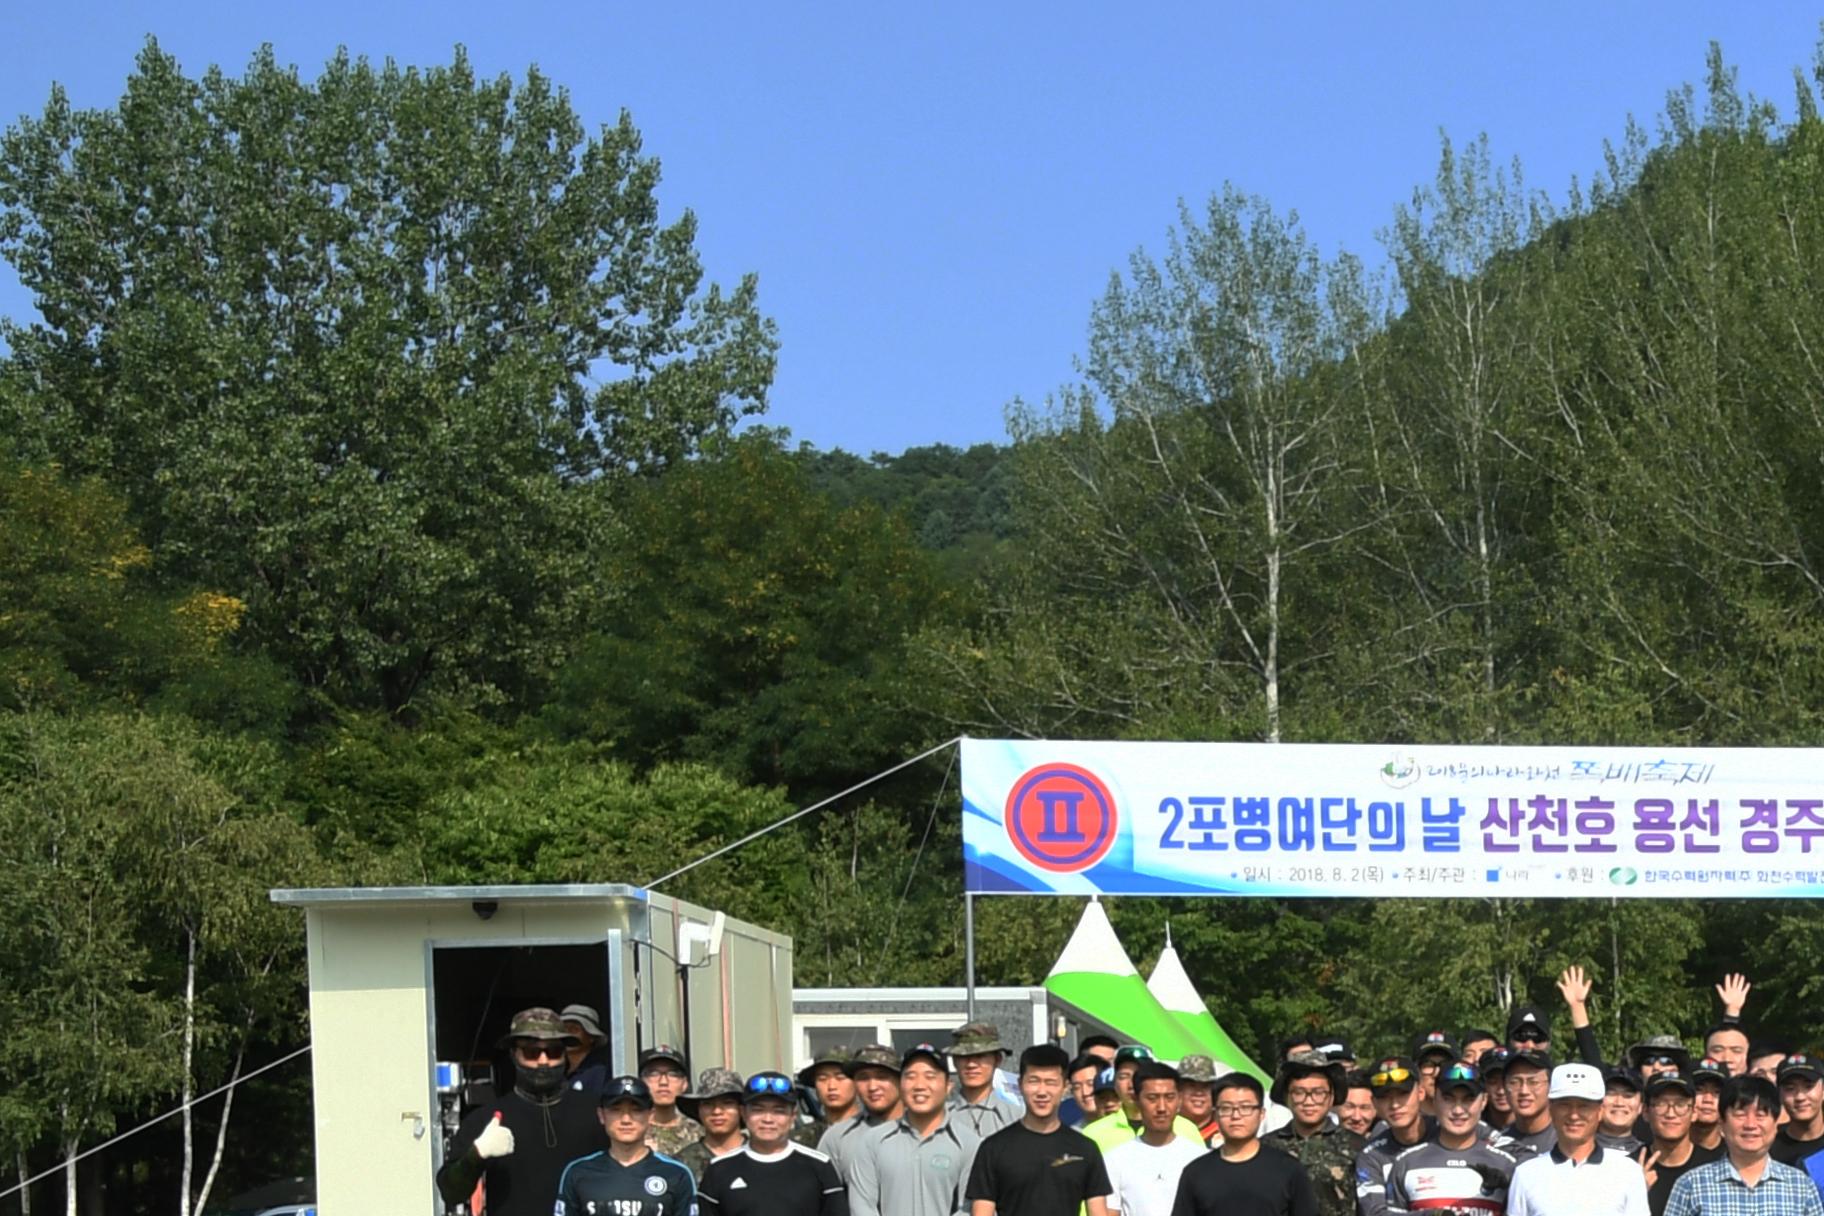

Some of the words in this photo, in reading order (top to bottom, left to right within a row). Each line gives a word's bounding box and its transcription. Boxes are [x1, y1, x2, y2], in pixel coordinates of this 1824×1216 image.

[1157, 796, 1406, 852] 2포병여단의
[1421, 797, 1466, 853] 날
[1480, 794, 1618, 853] 산천호
[1633, 797, 1721, 854] 용선
[1243, 866, 1271, 882] 일시
[1402, 865, 1465, 883] 주최/주관
